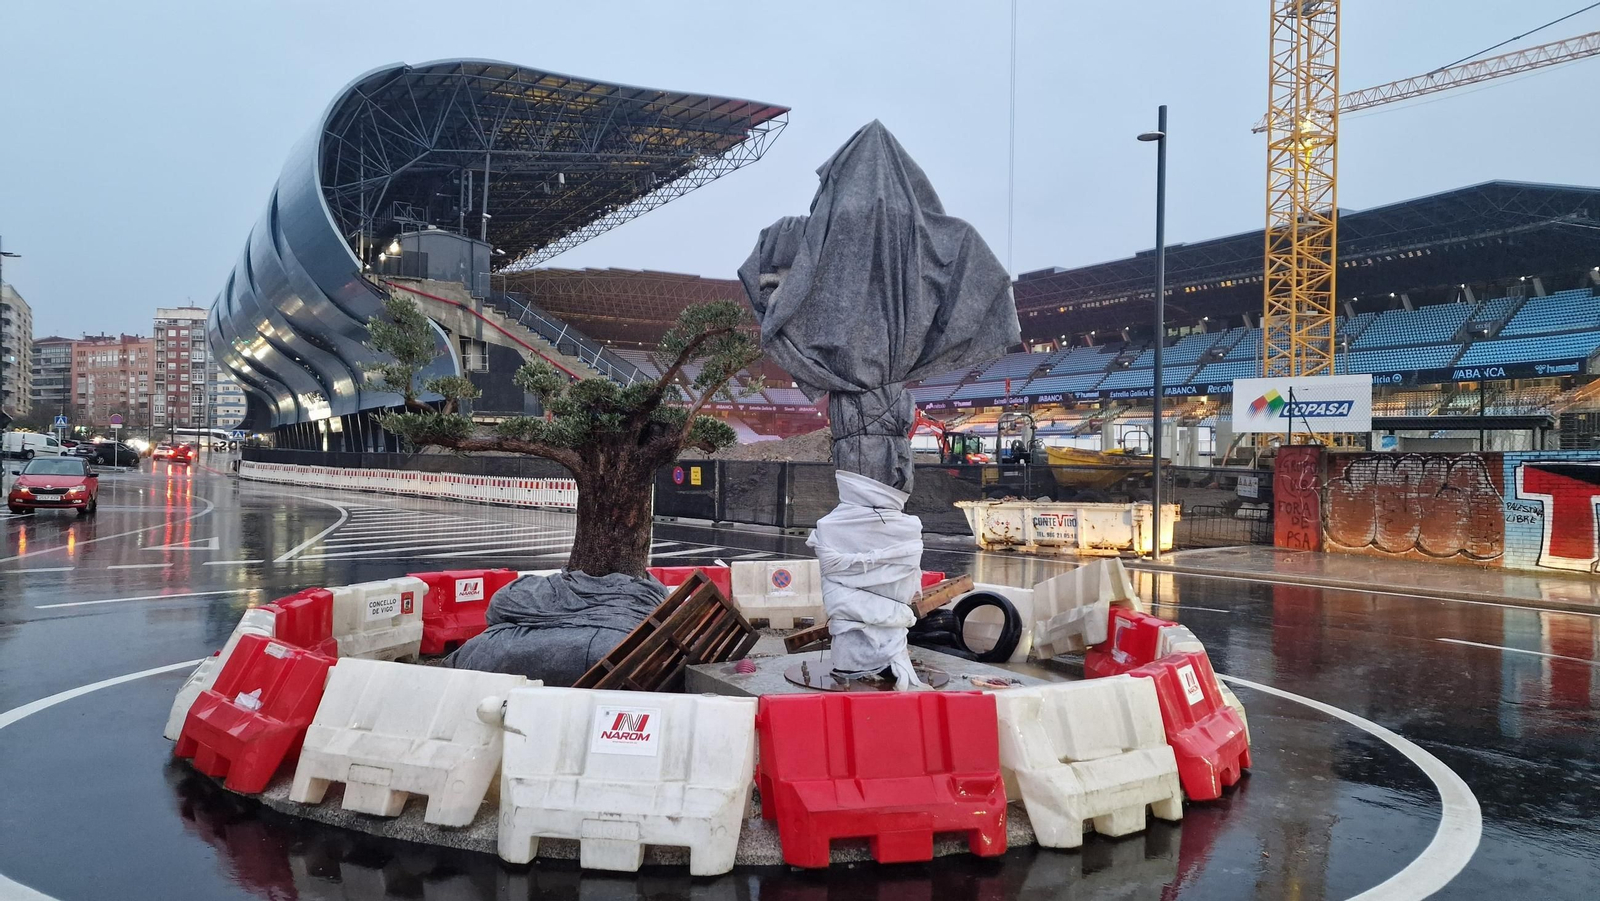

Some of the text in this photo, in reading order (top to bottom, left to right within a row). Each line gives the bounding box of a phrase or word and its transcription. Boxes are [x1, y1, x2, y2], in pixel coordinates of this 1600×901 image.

[1546, 362, 1579, 373] hummel
[1371, 375, 1391, 384] licia
[1283, 402, 1349, 416] COPASA
[1278, 501, 1312, 517] FORA
[1292, 516, 1309, 529] DE
[1287, 531, 1311, 550] PSA
[369, 598, 397, 608] CONCELLO
[601, 731, 651, 741] NAROM
